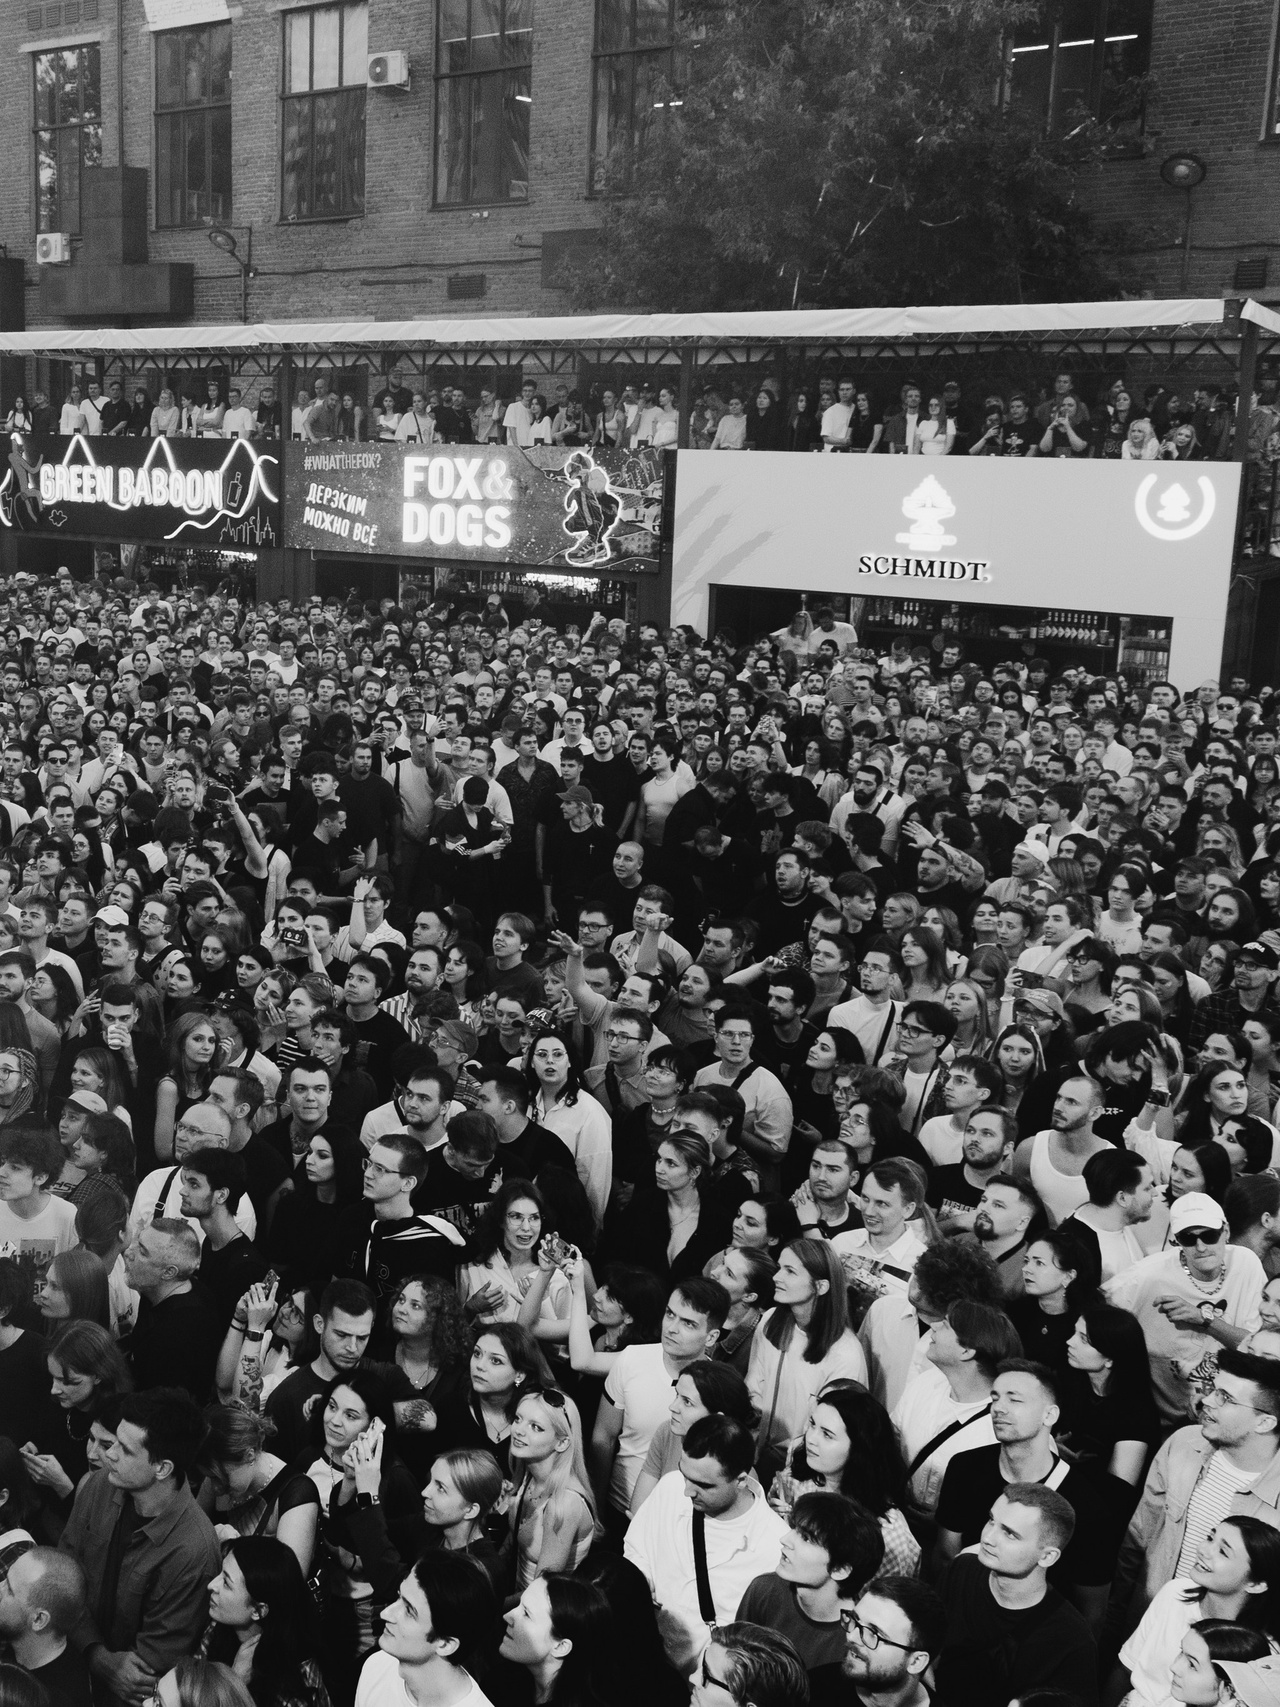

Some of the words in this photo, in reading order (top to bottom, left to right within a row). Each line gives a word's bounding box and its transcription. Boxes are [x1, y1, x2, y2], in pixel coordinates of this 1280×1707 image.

[40, 462, 113, 506] GREEN
[118, 465, 225, 512] BABOON
[302, 506, 351, 538] МОЖНО
[352, 522, 379, 547] ВСЁ
[402, 501, 513, 549] DOGS
